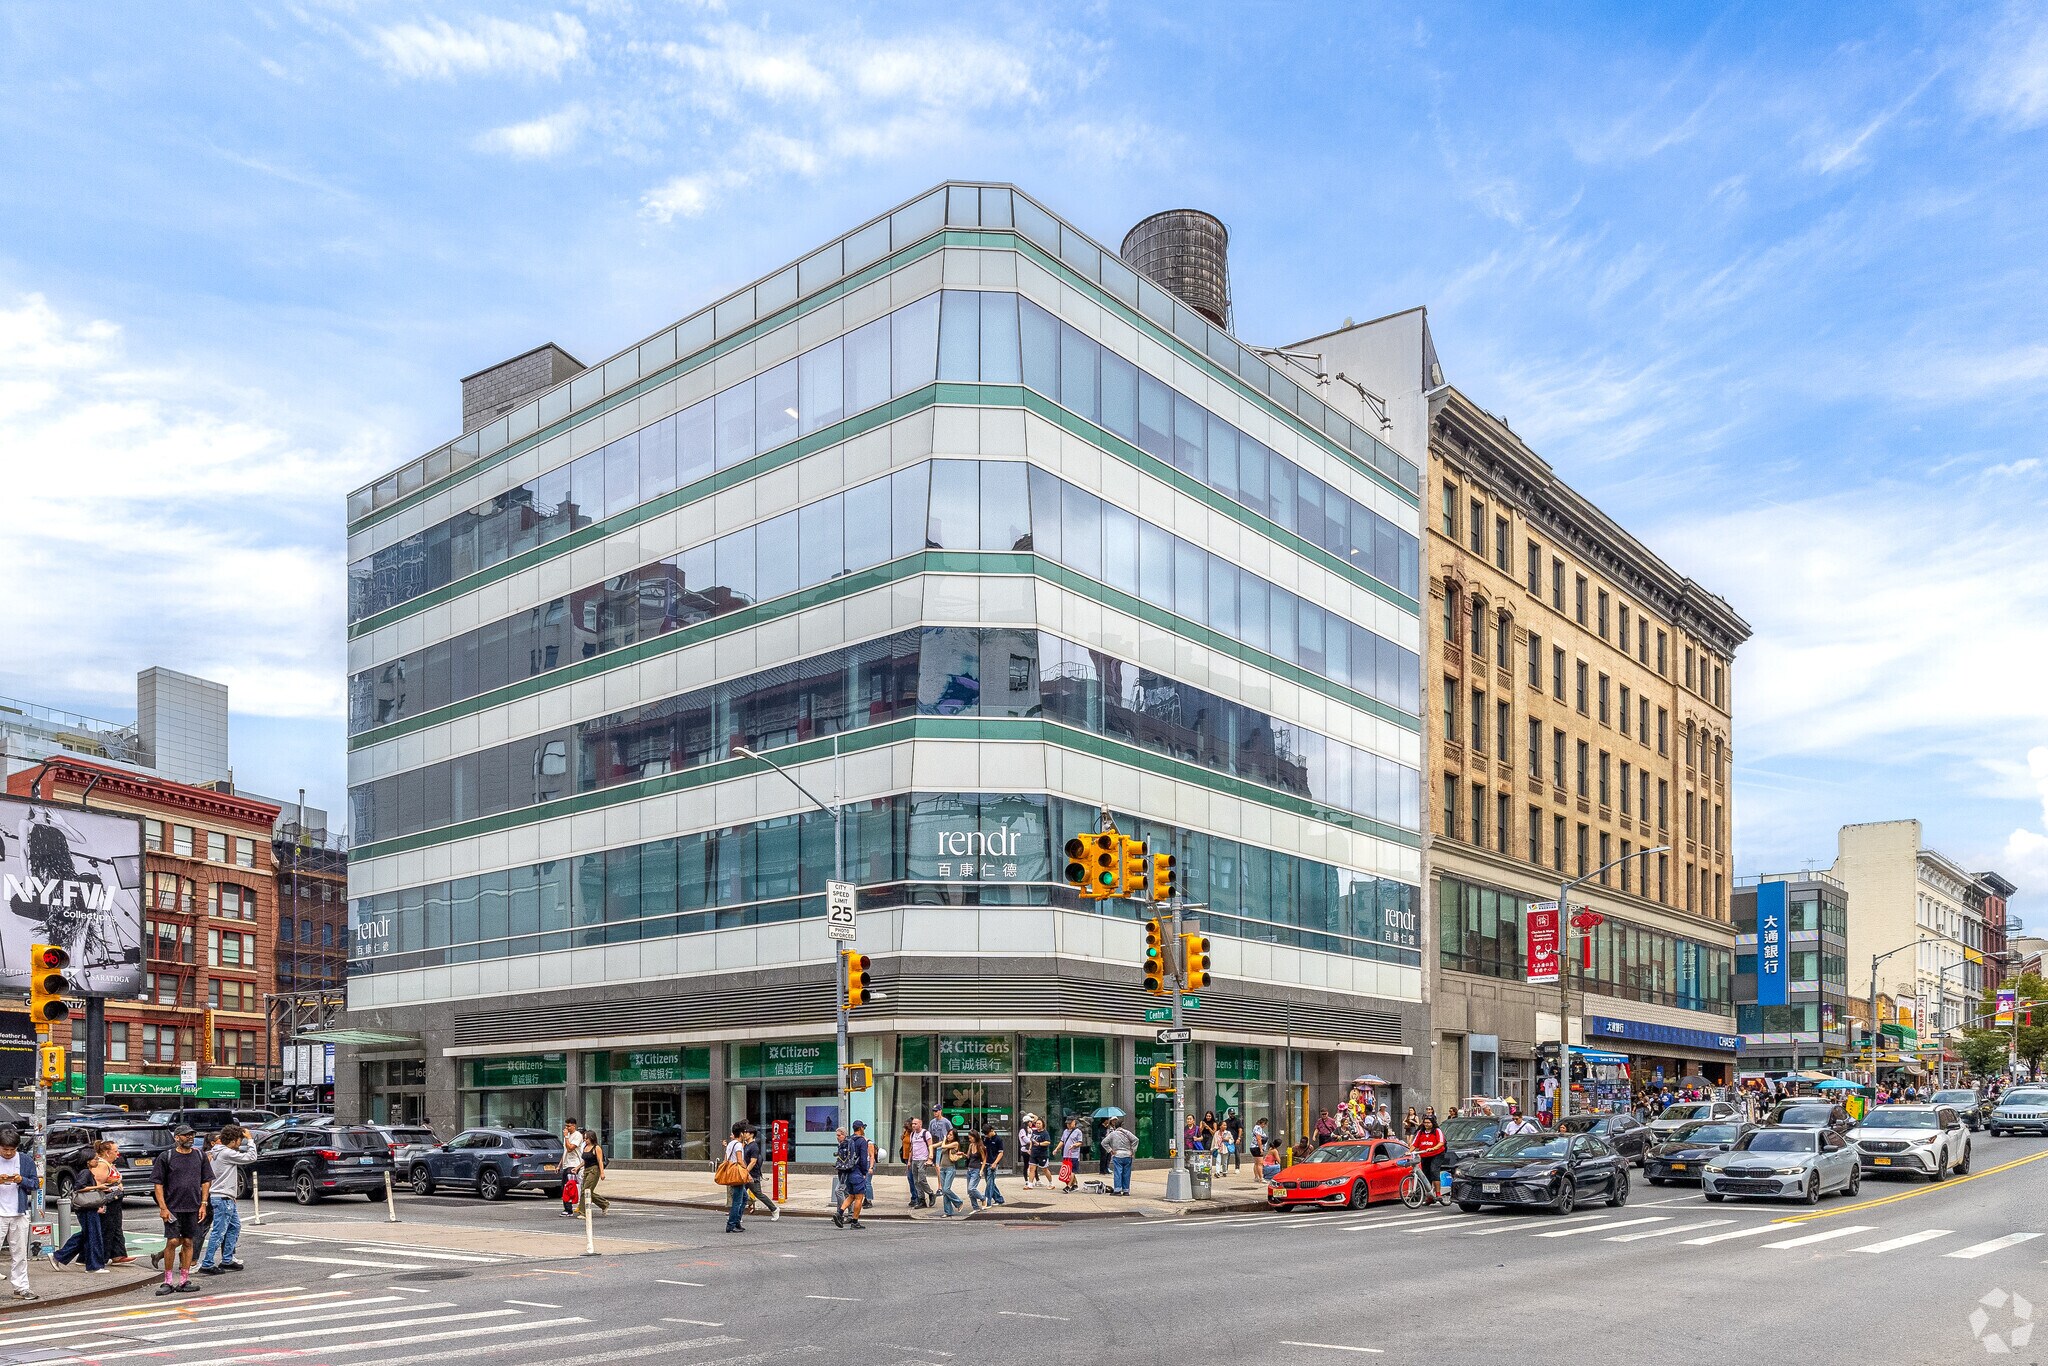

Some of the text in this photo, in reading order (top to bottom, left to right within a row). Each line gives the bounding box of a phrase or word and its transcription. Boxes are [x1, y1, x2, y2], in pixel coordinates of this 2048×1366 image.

[938, 825, 1021, 856] rendr
[938, 862, 1017, 877] 百康仁德
[832, 890, 850, 898] SPEED
[831, 905, 853, 922] 25
[1385, 909, 1416, 930] rendr
[357, 915, 391, 940] rendr
[830, 931, 854, 939] ENFORCED
[1763, 915, 1778, 974] 大通銀行
[91, 974, 129, 983] SARATOGA
[1182, 998, 1194, 1006] Canal
[1149, 1011, 1164, 1019] Centre
[954, 1041, 1010, 1053] Citizens
[1718, 1036, 1736, 1048] CHASE
[780, 1046, 820, 1058] Citizens
[644, 1053, 679, 1064] Citizens
[947, 1058, 1002, 1071] 信诚银行
[514, 1060, 543, 1071] Citizens
[774, 1062, 814, 1075] 信诚银行
[640, 1067, 673, 1080] 信诚银行
[112, 1083, 147, 1092] LILY'S
[149, 1084, 173, 1094] Vegan
